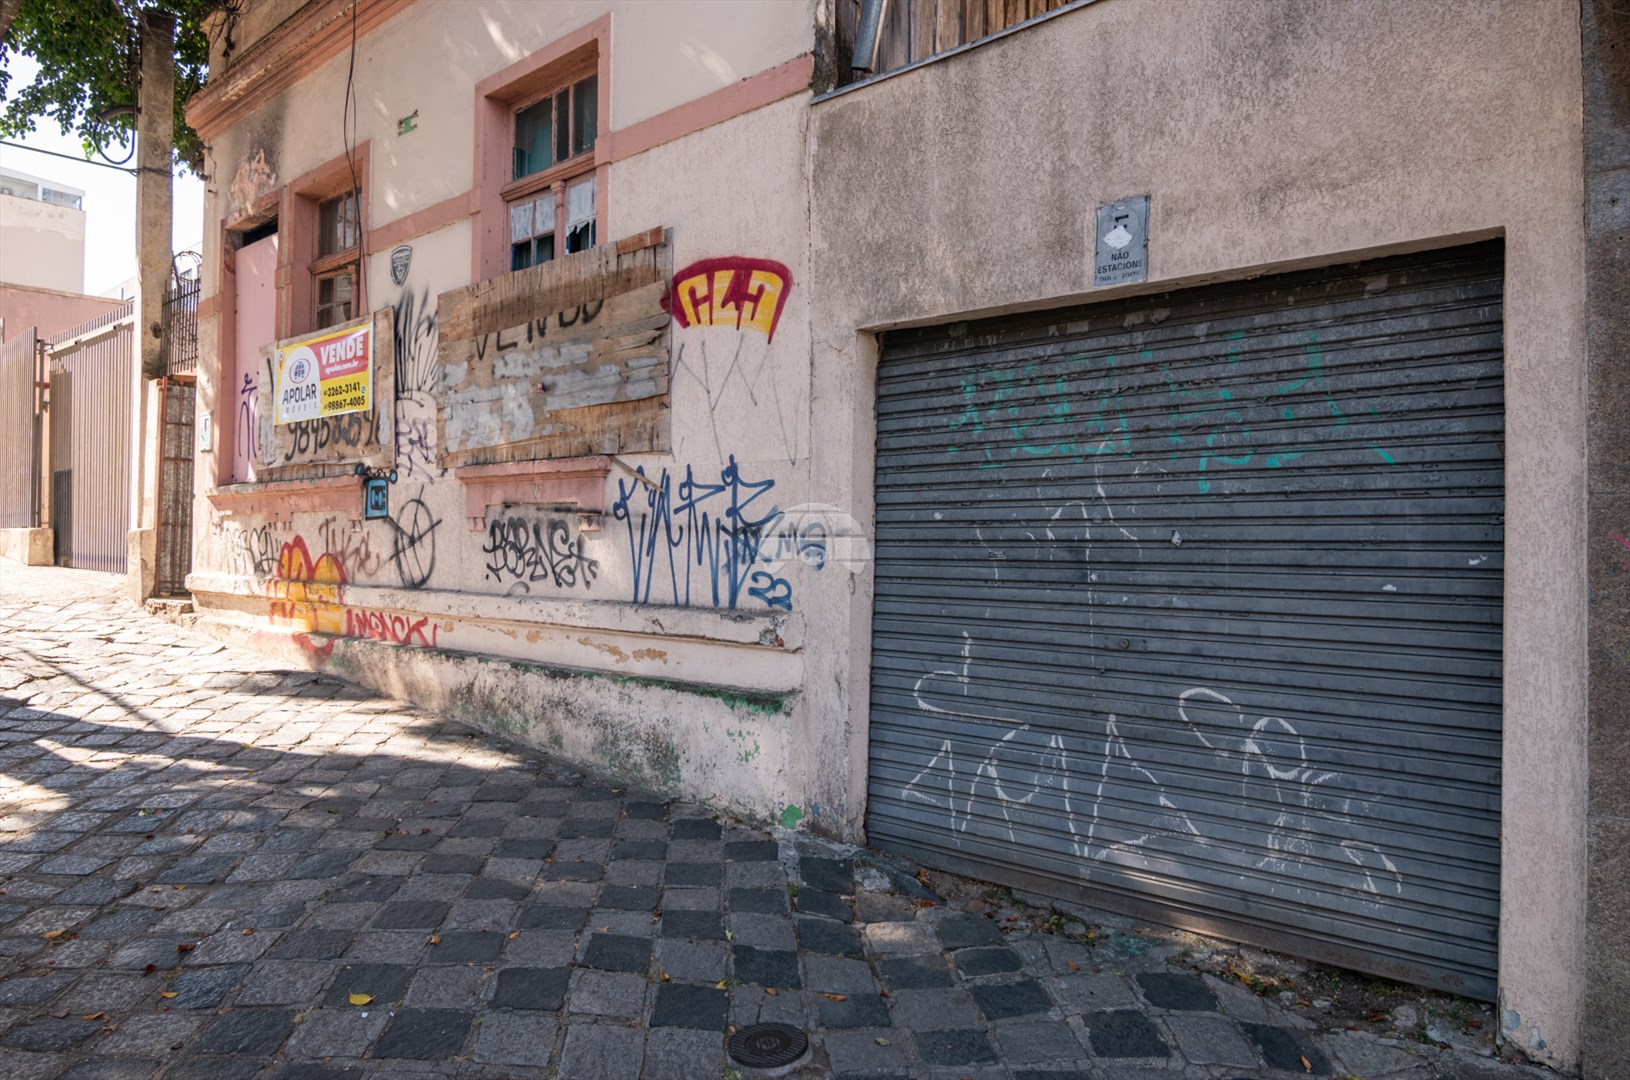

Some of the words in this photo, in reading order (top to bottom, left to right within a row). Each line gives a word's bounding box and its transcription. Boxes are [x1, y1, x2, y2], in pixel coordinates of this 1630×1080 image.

[1097, 258, 1143, 274] ESTACIONE
[320, 336, 364, 366] VENDE
[283, 384, 317, 404] APOLAR
[327, 395, 365, 411] 98867-4005
